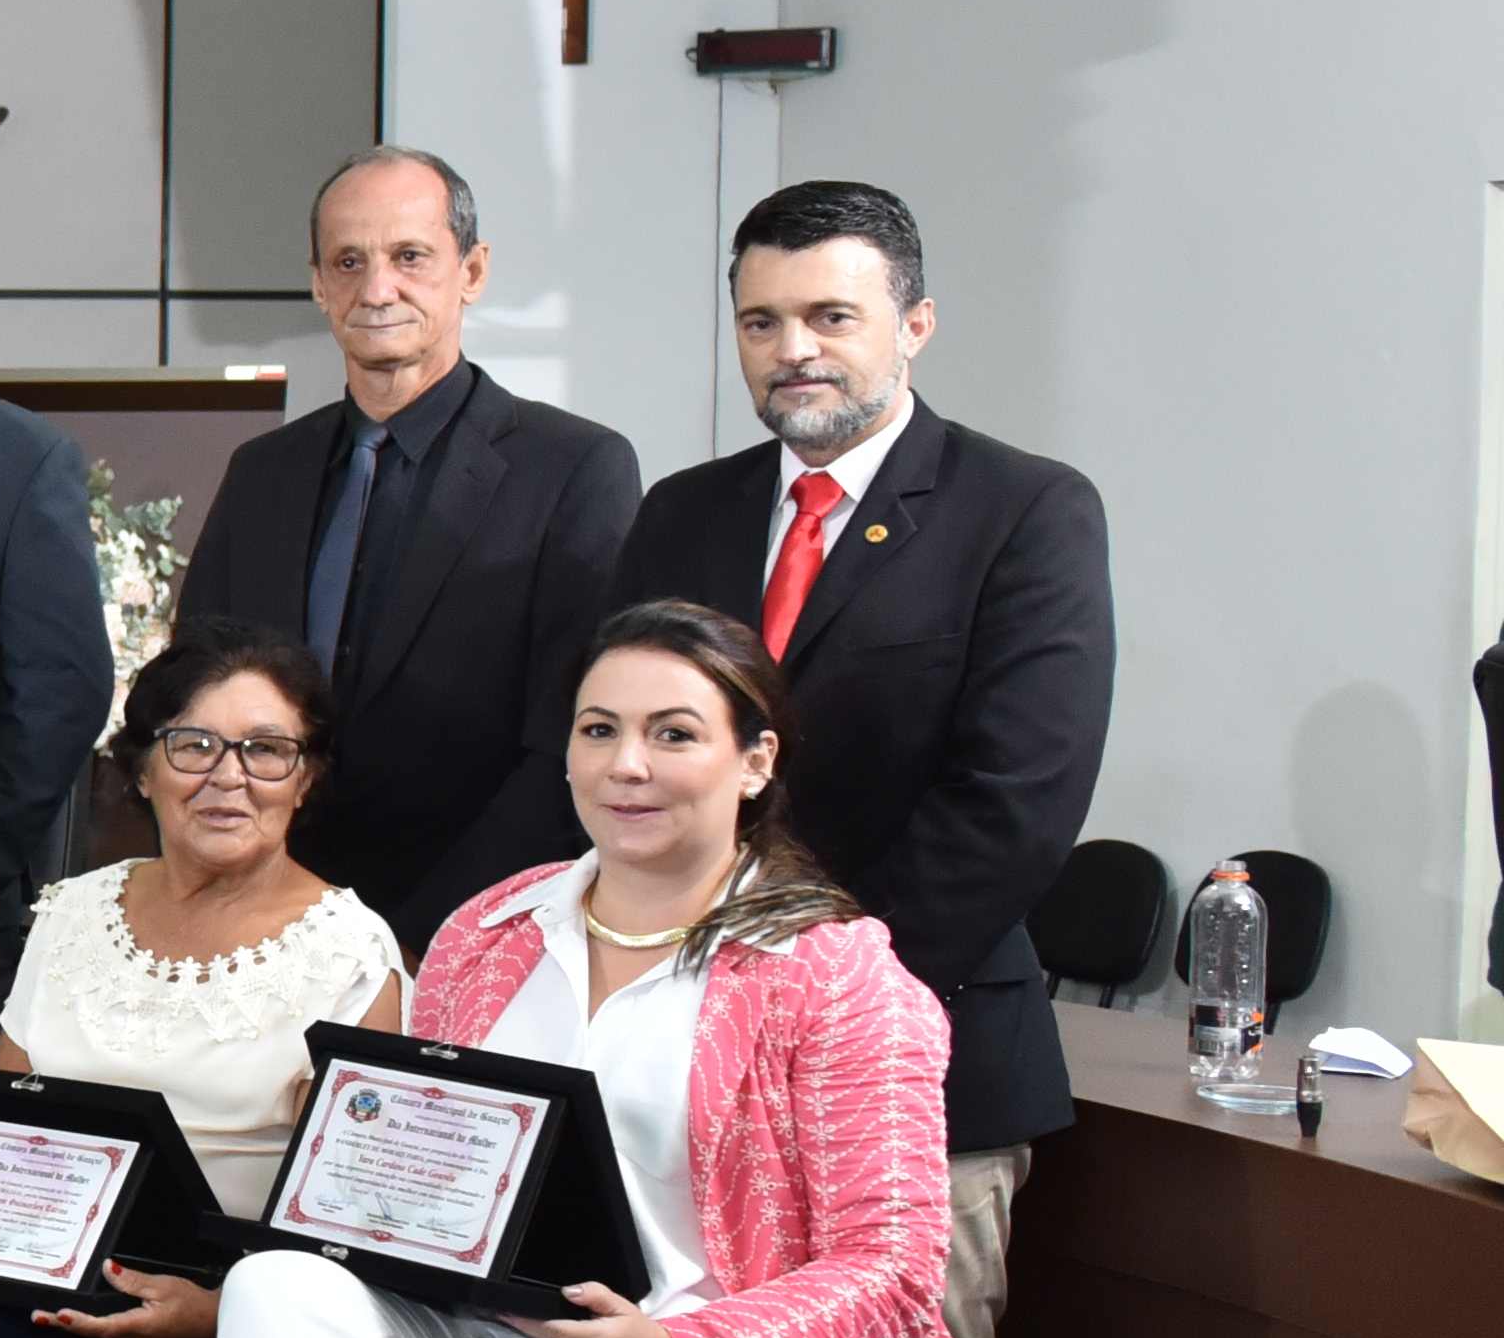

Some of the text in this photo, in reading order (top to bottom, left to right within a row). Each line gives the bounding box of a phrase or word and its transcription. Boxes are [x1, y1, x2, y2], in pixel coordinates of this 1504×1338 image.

[422, 1100, 468, 1118] Municipal
[466, 1109, 479, 1120] de
[385, 1117, 498, 1150] Dia Internacional da Mulher
